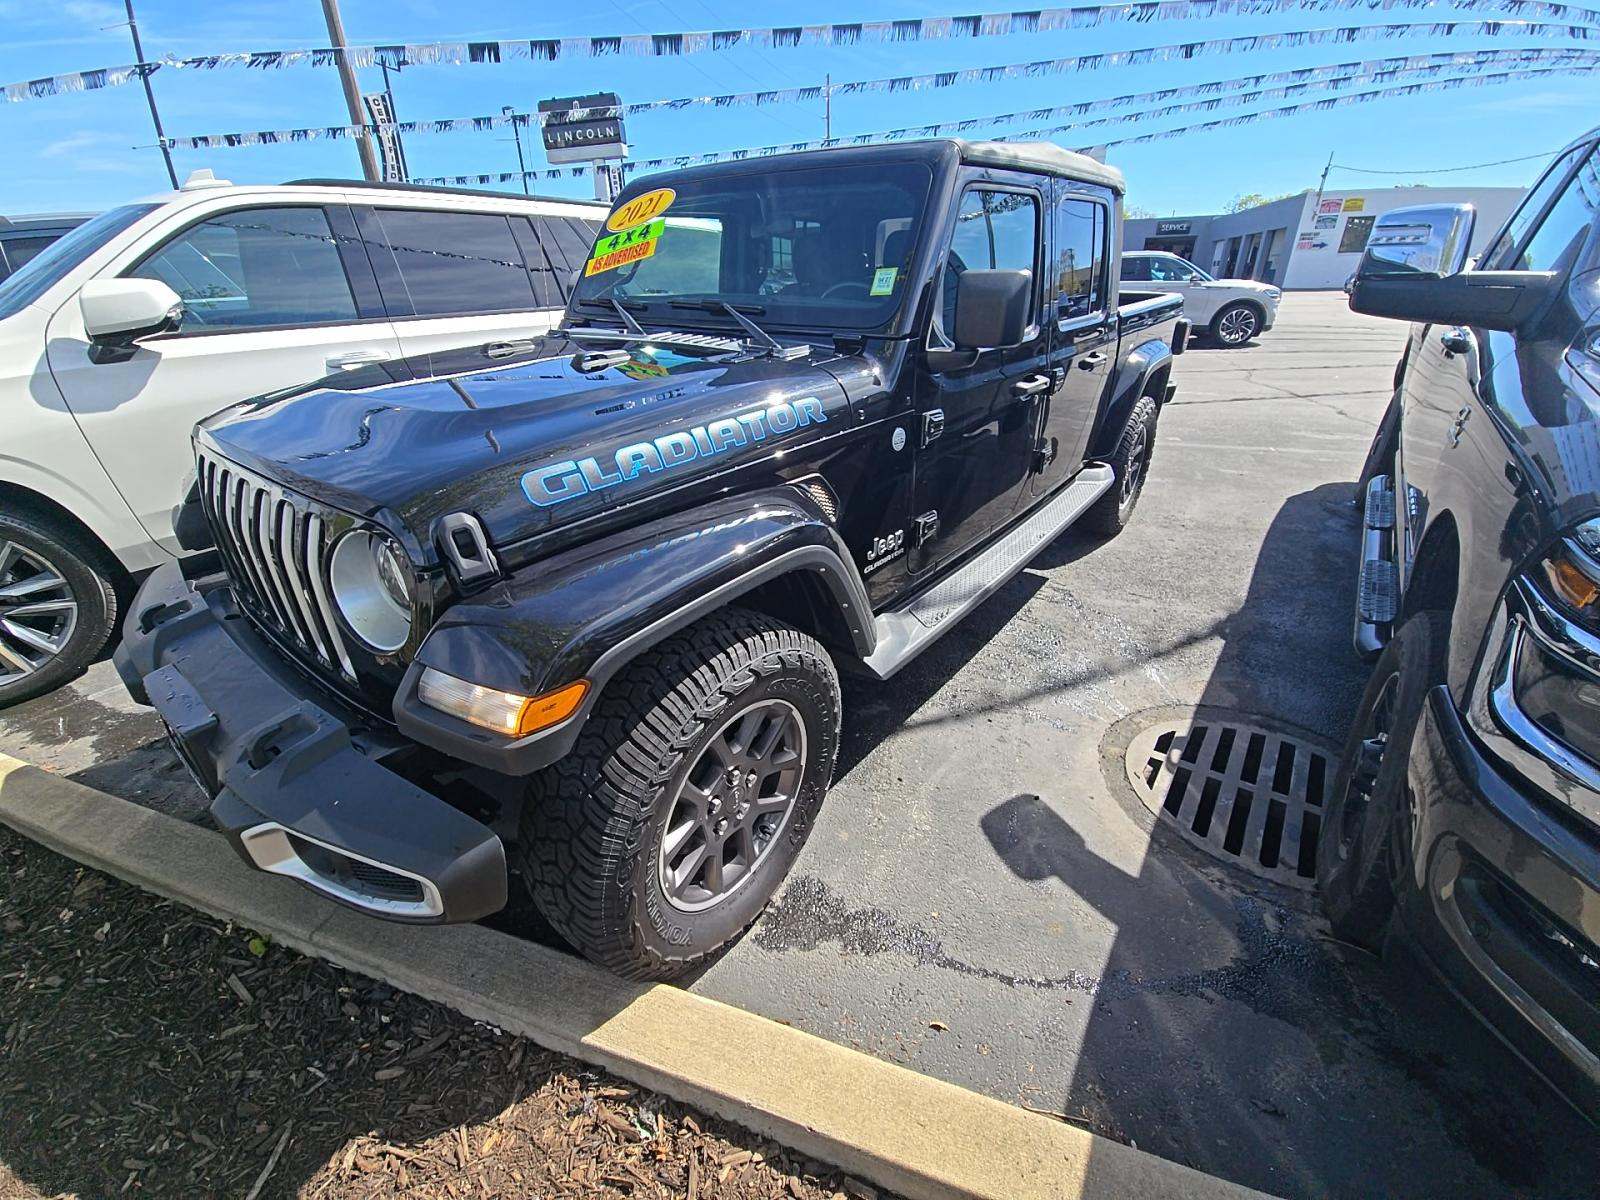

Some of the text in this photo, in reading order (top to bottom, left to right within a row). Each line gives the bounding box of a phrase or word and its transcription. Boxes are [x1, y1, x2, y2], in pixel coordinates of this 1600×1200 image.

[547, 126, 614, 143] LINCOLN
[617, 192, 665, 228] 2021
[1161, 223, 1187, 232] SERVICE
[592, 241, 651, 270] AS ADVERTISED
[521, 396, 828, 507] GLADIATOR
[867, 529, 904, 560] Jeep
[863, 547, 904, 574] GLADIATOR
